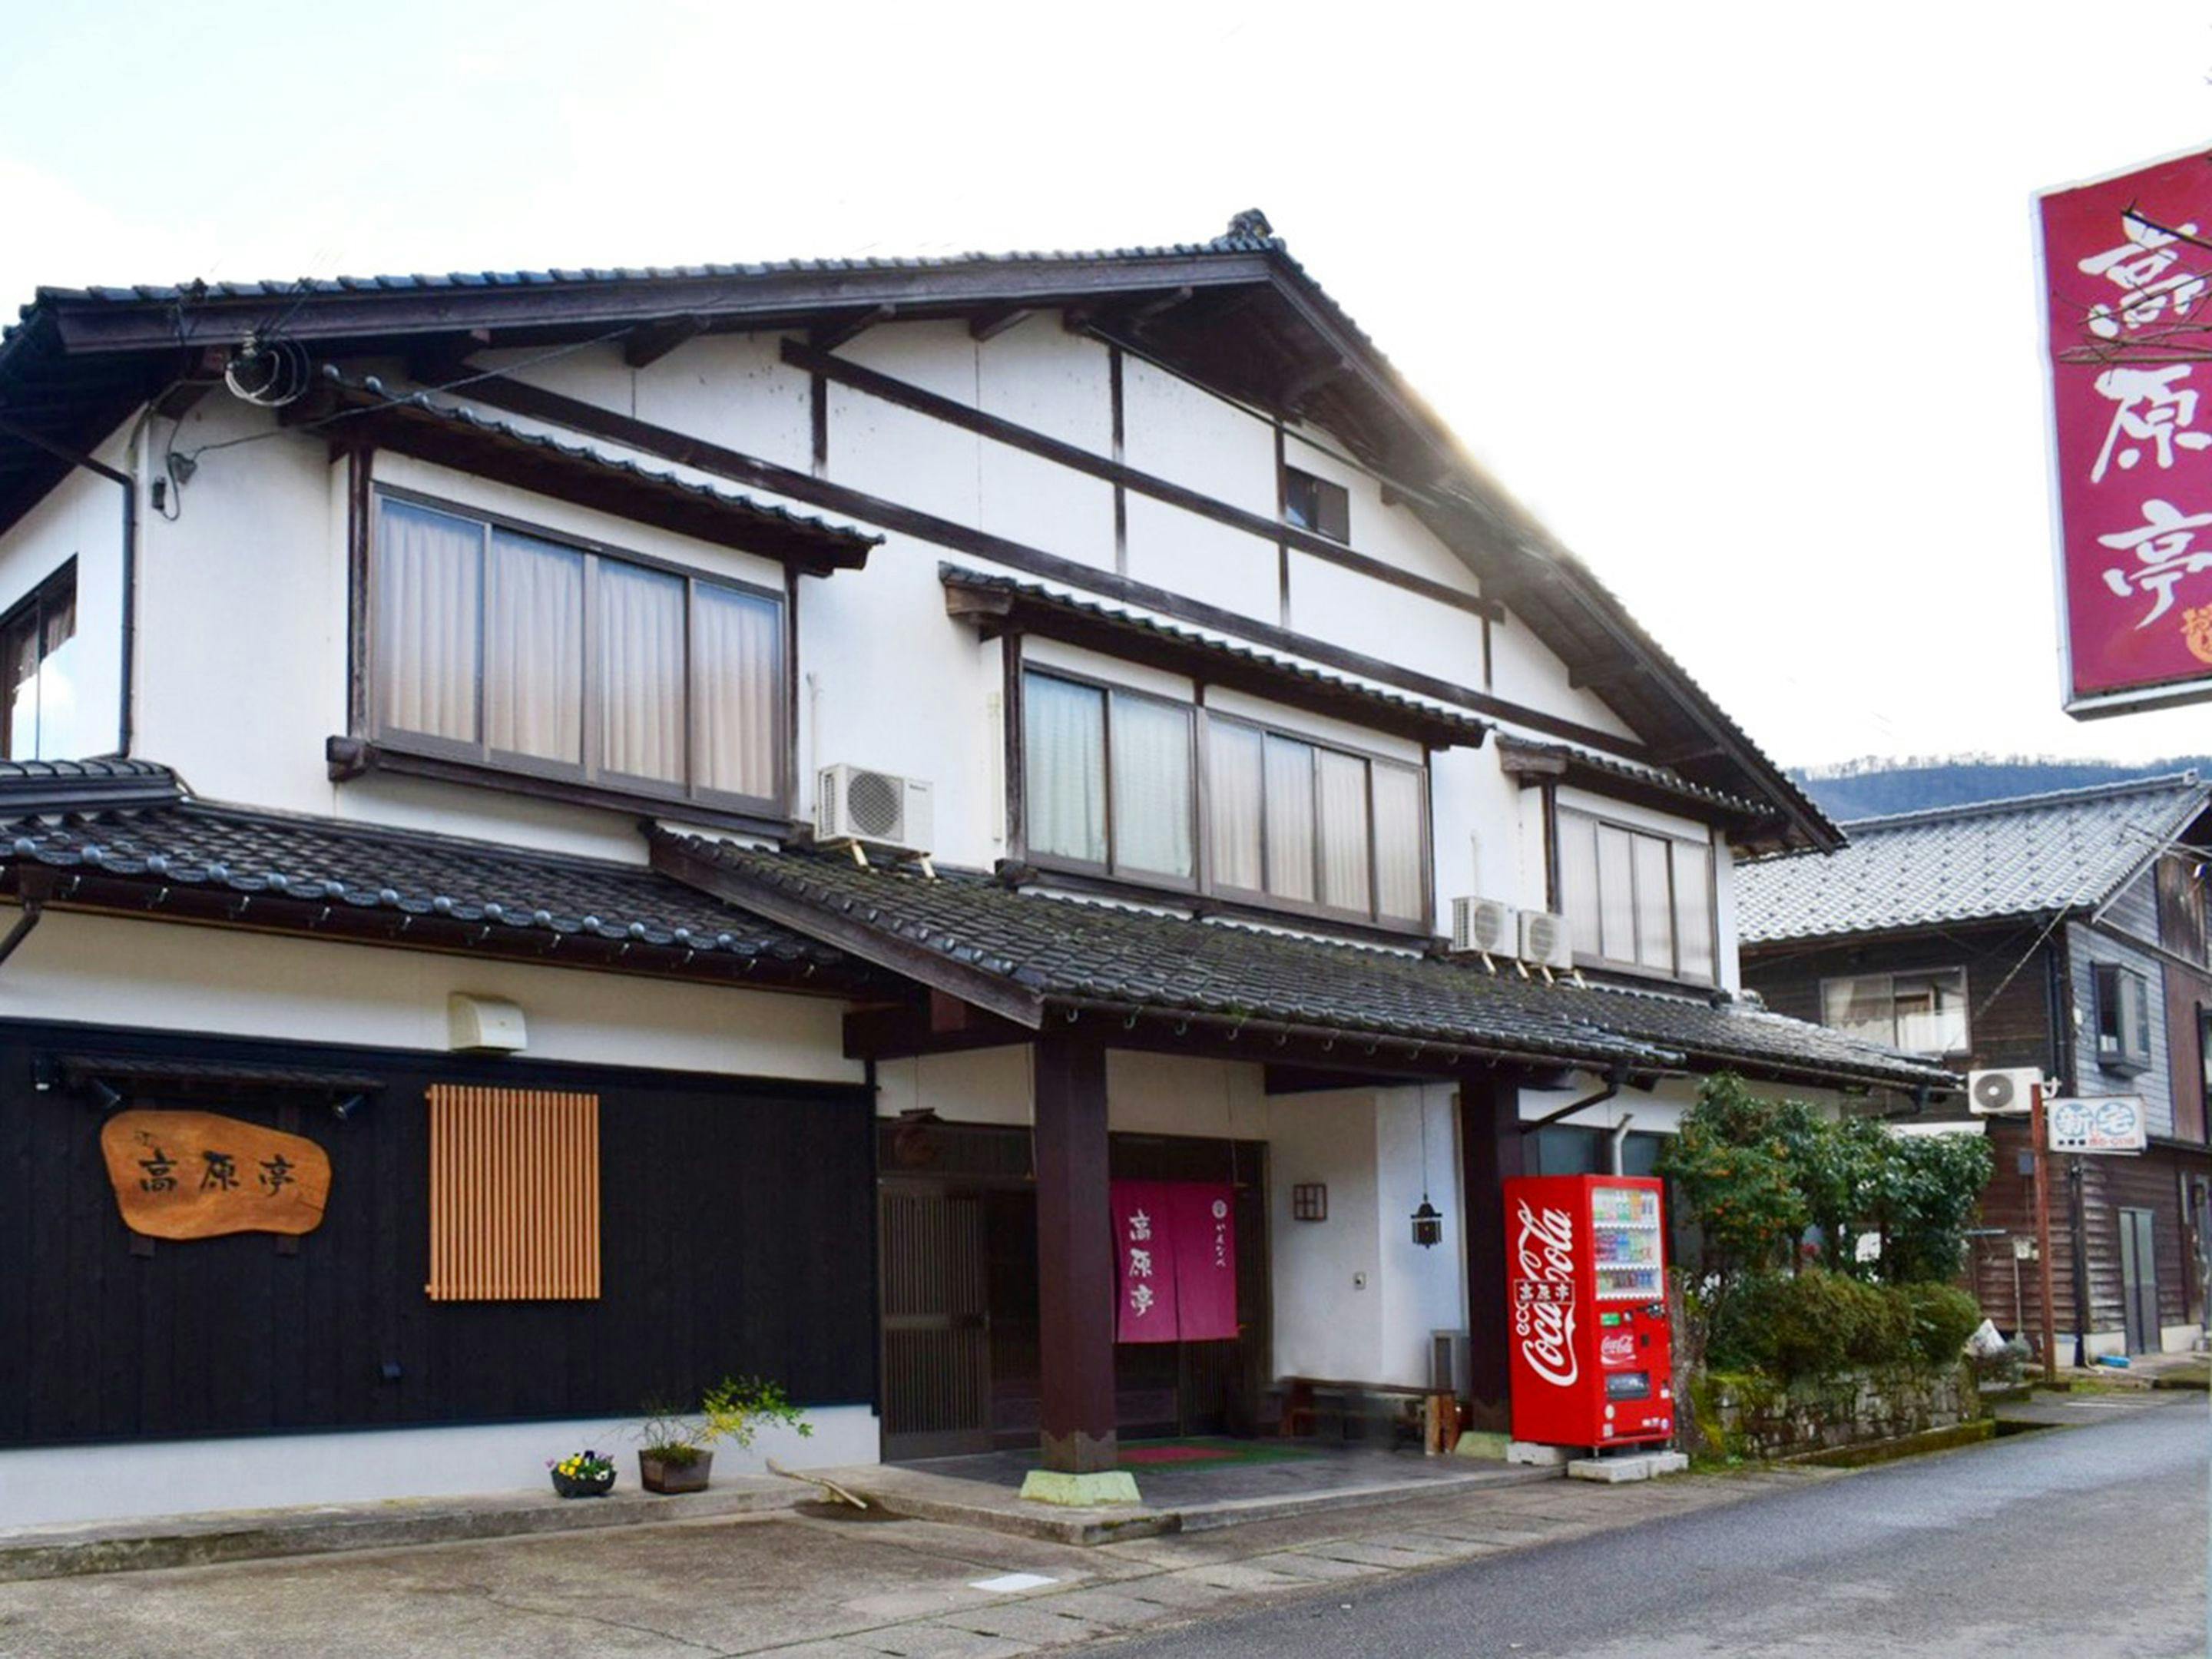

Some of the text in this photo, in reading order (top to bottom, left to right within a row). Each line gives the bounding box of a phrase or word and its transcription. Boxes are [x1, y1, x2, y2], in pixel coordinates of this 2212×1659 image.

[2078, 212, 2212, 629] 高原亭
[141, 1149, 295, 1195] 高原亭
[1129, 1209, 1153, 1316] 高原亭
[1518, 1198, 1578, 1386] CocaCola
